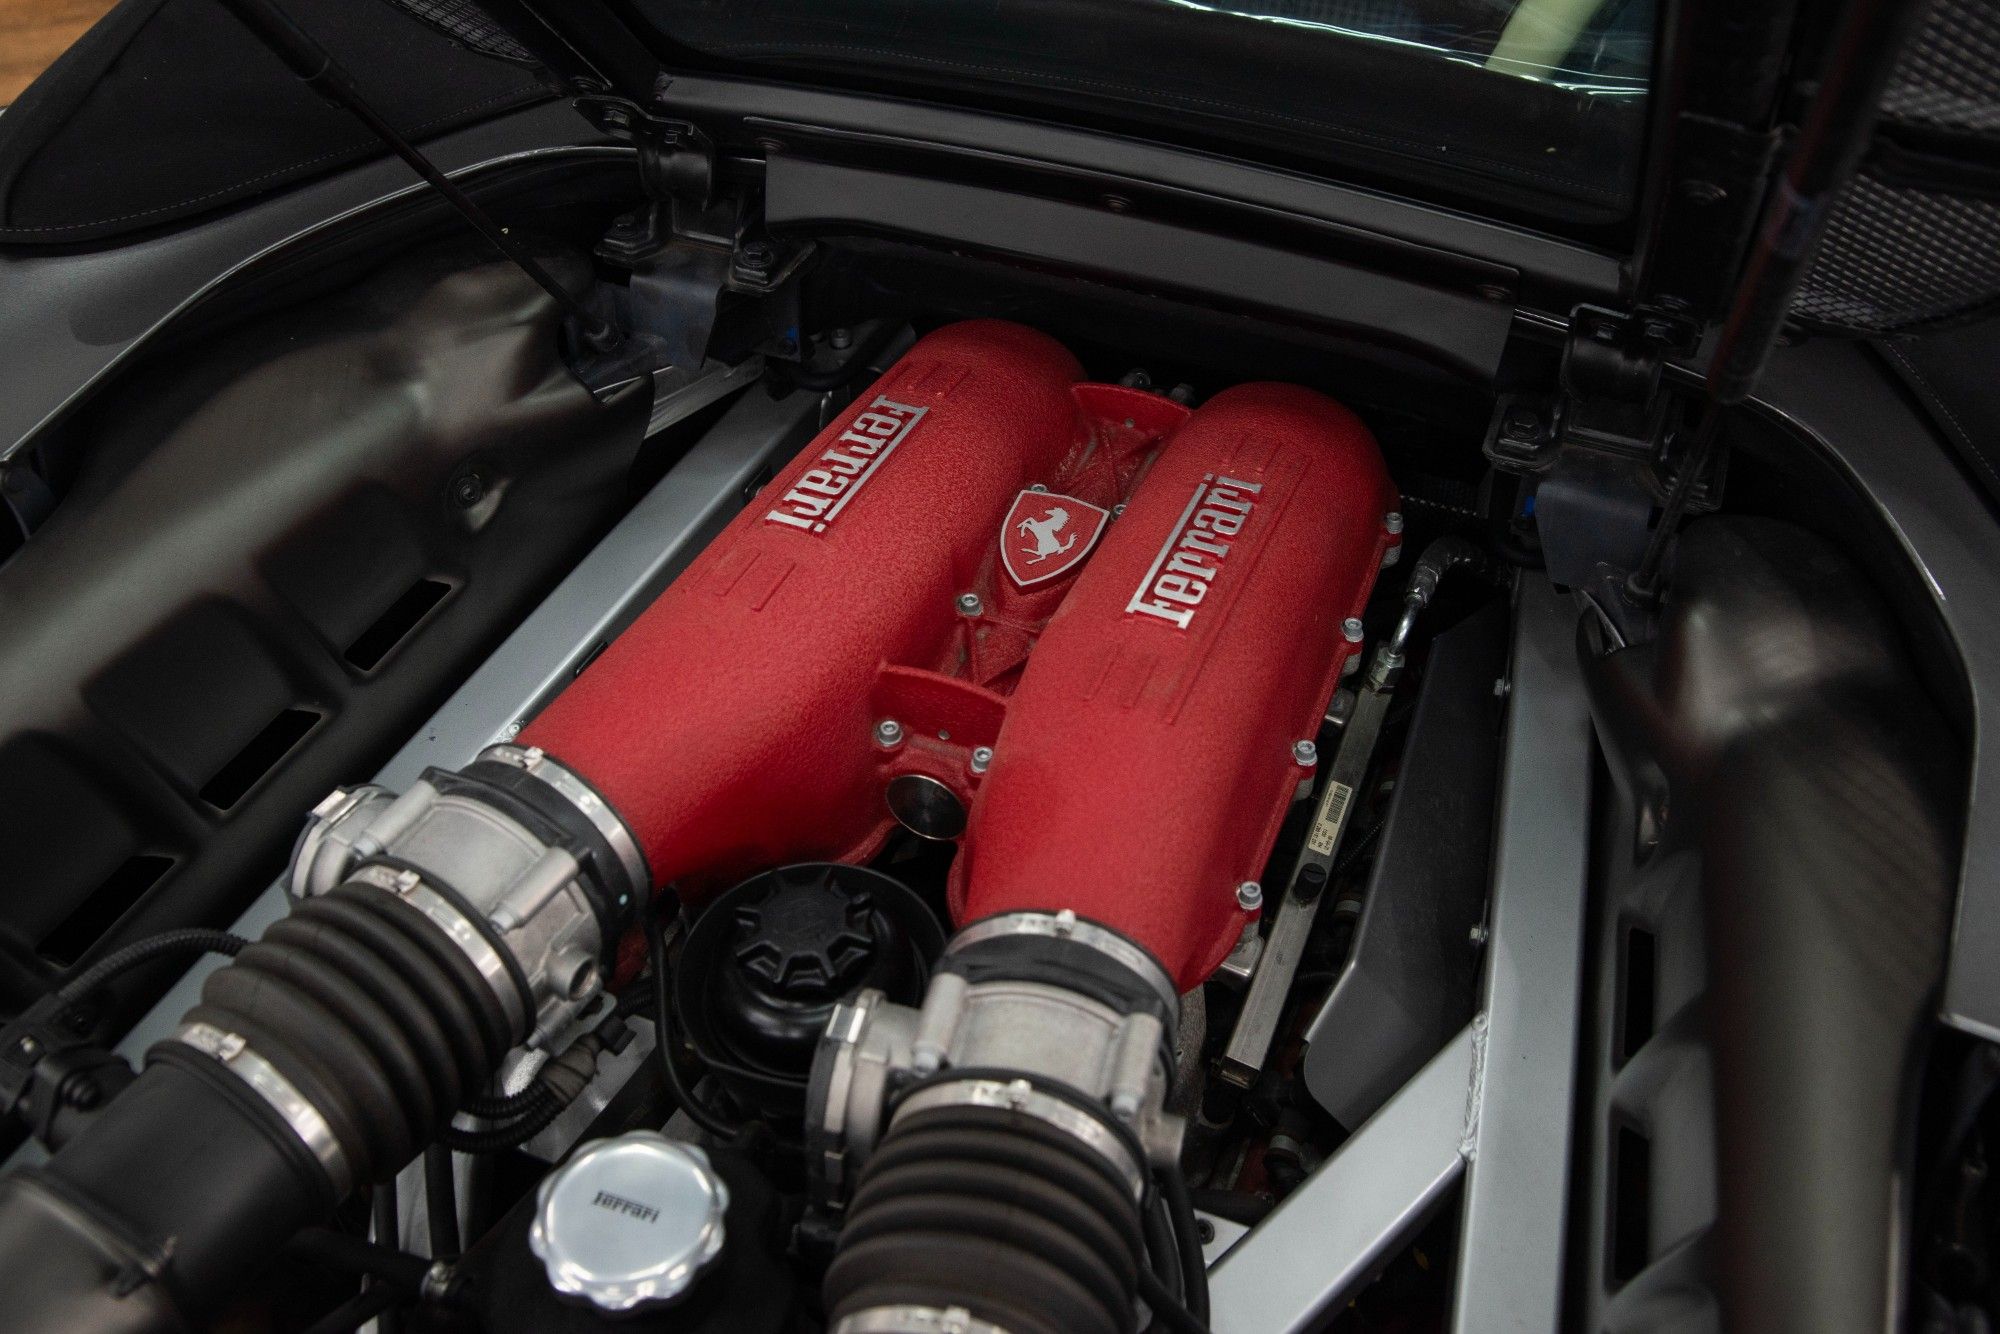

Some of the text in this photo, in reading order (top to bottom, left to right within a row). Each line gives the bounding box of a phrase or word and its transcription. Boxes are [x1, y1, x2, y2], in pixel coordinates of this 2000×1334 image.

[765, 394, 930, 532] Ferrari
[1125, 473, 1264, 629] Ferrari
[592, 1190, 660, 1224] Ferrari
